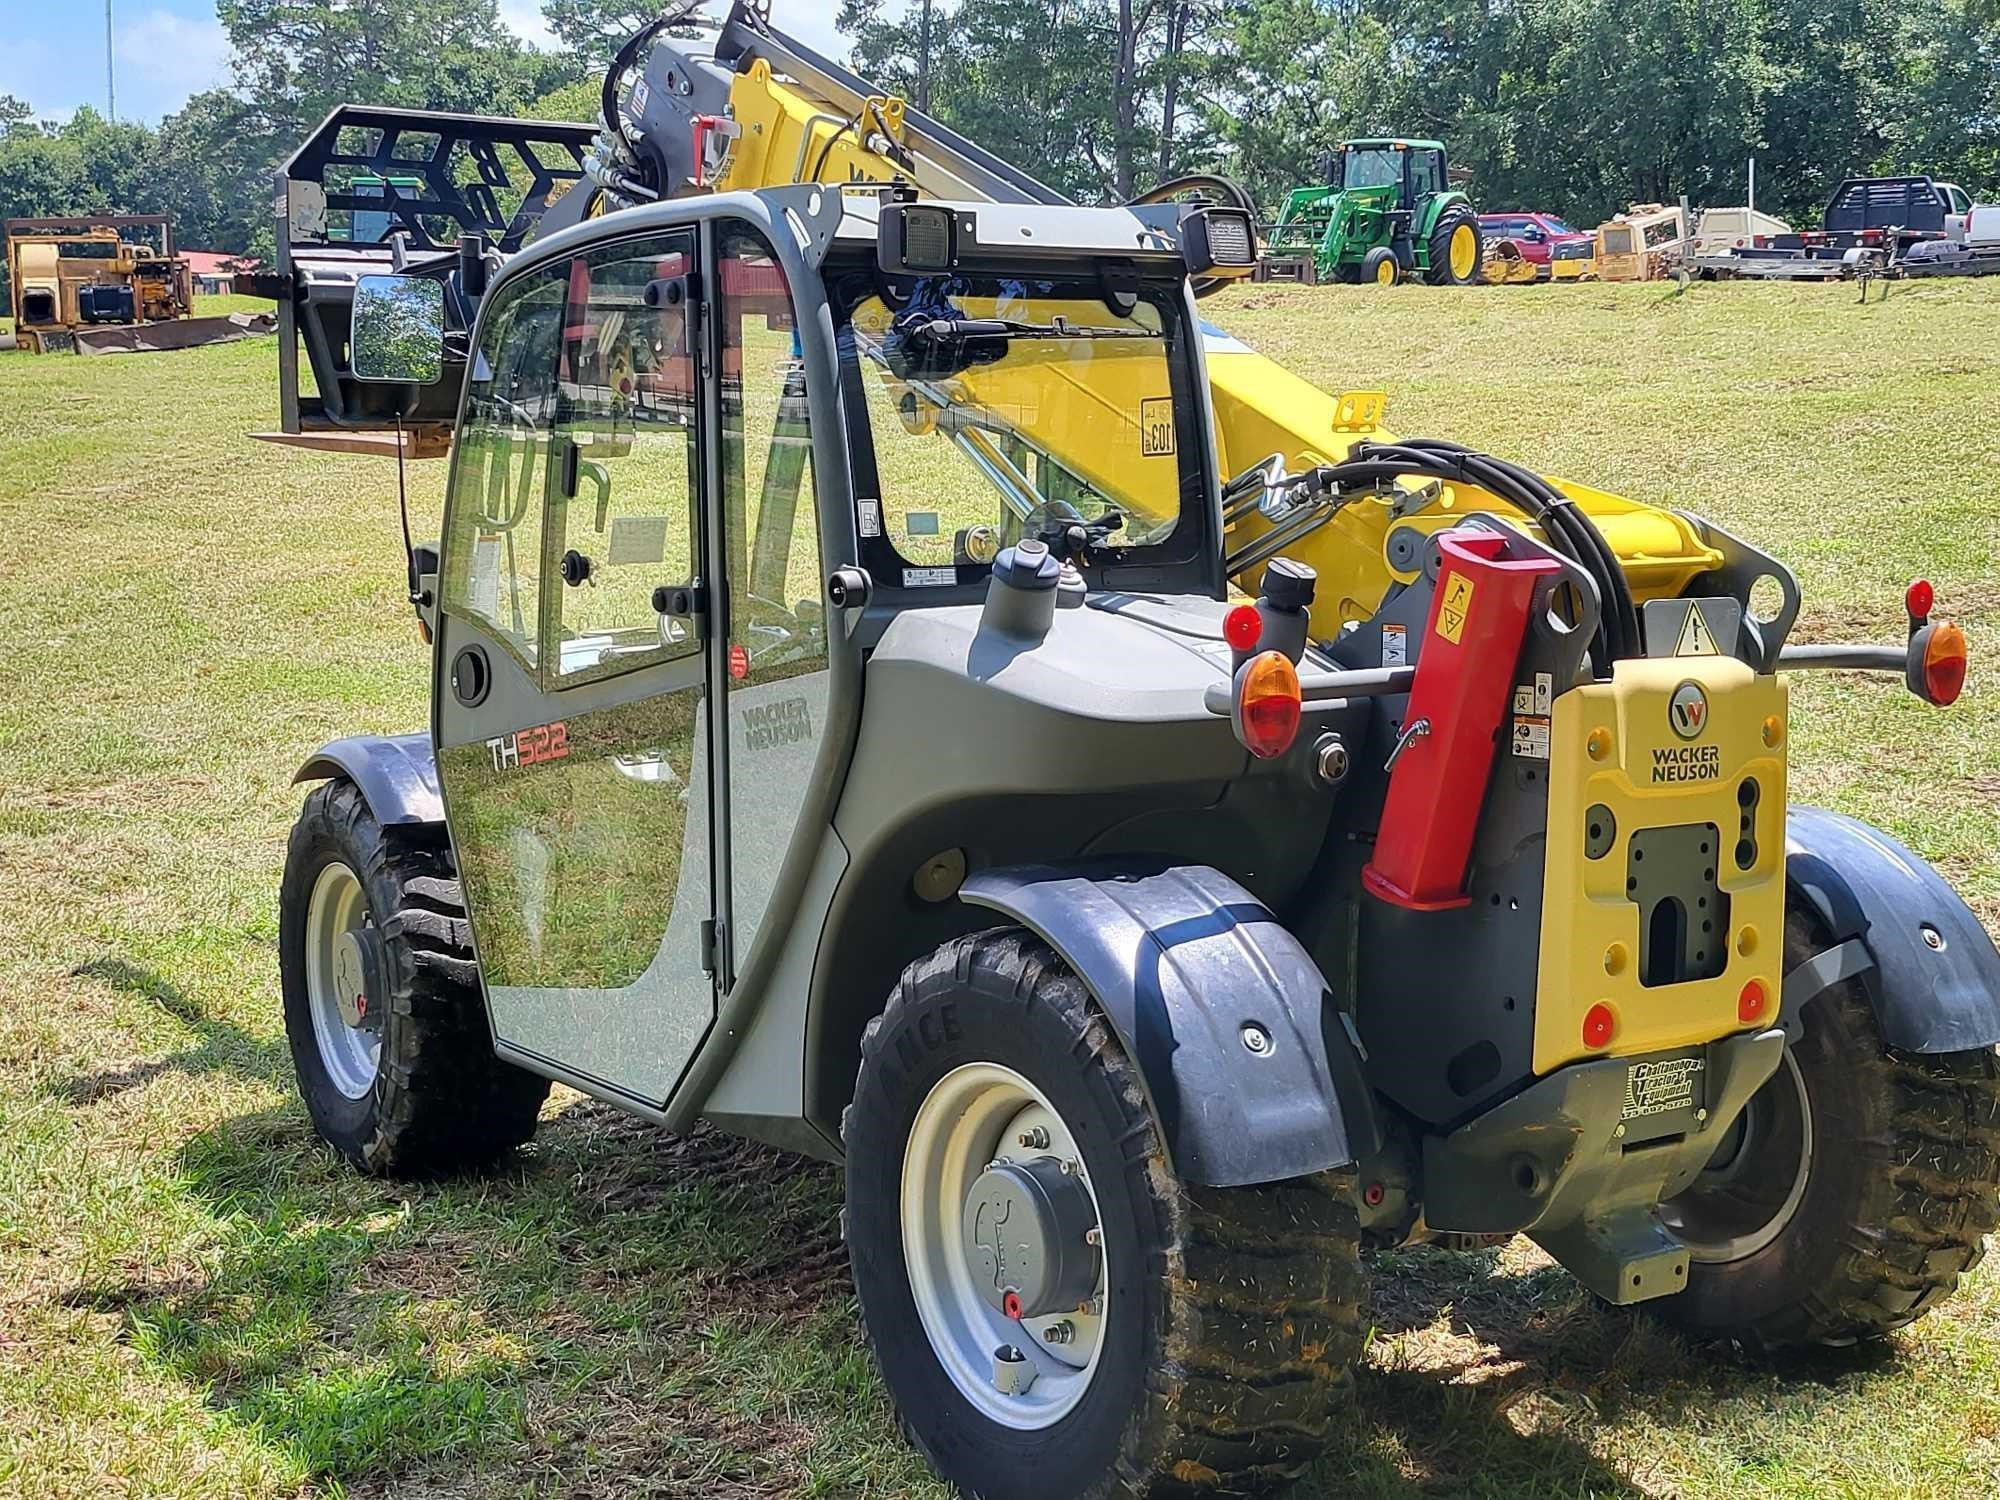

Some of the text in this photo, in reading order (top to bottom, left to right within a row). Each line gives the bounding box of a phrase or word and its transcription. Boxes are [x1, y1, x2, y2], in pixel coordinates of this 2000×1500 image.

[742, 698, 811, 730] WACKER
[486, 721, 570, 772] TH522
[745, 718, 813, 752] NEUSON
[1652, 746, 1719, 765] WACKER
[1652, 763, 1719, 783] NEUSON
[1634, 1059, 1701, 1080] Chattanooga
[1637, 1072, 1679, 1095] Tractor
[1639, 1080, 1692, 1107] Equipment
